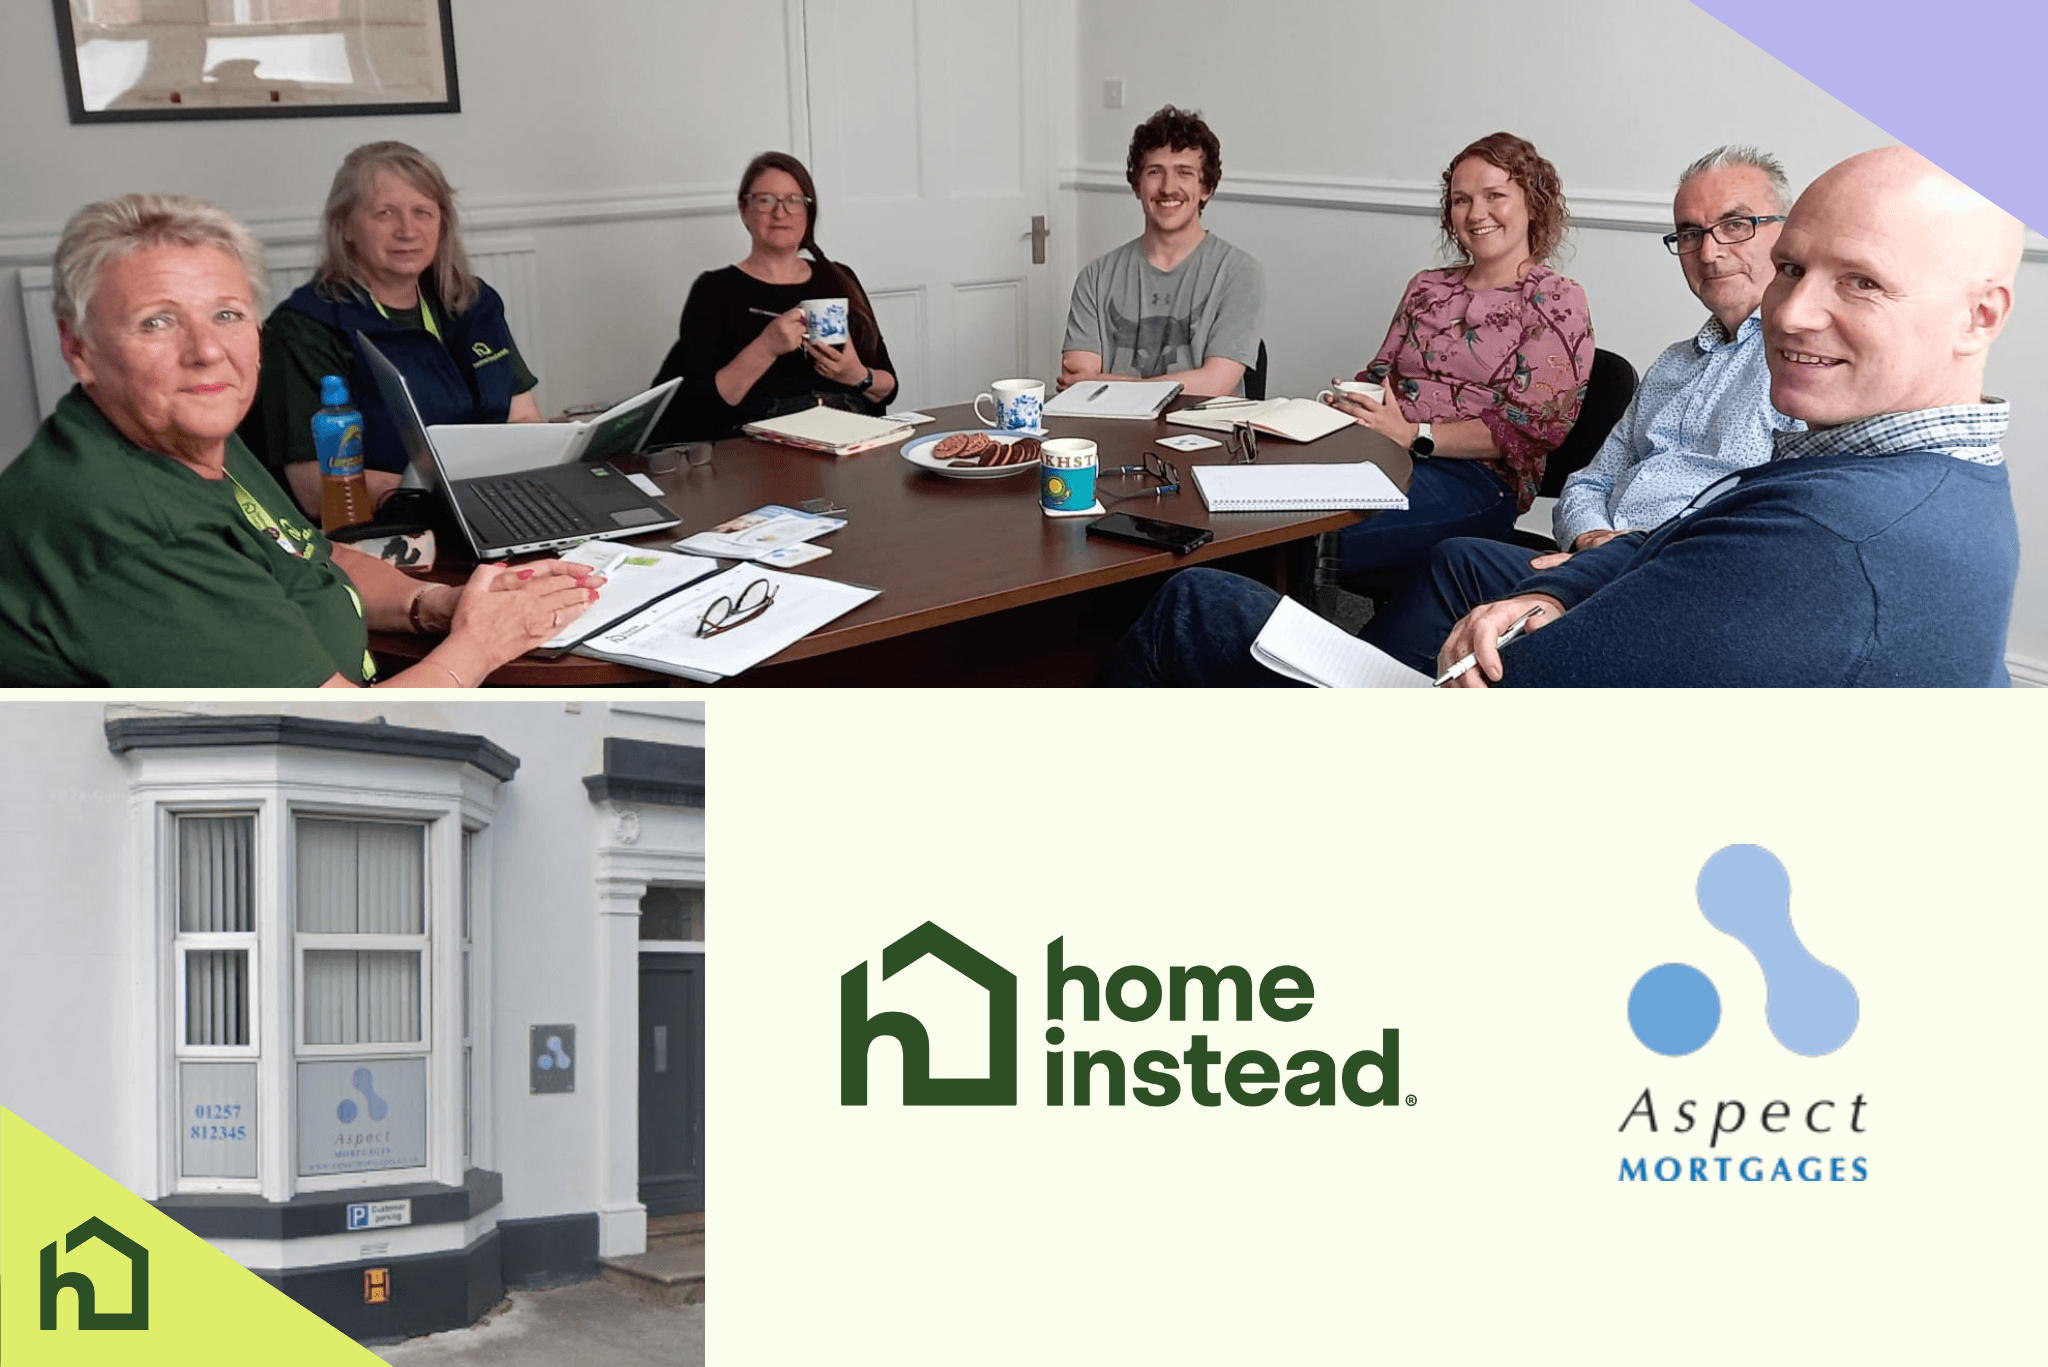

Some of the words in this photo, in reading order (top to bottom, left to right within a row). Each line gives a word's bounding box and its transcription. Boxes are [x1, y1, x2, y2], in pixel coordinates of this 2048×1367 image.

[194, 1104, 242, 1119] 01257
[189, 1125, 247, 1141] 812345
[354, 1207, 366, 1226] P
